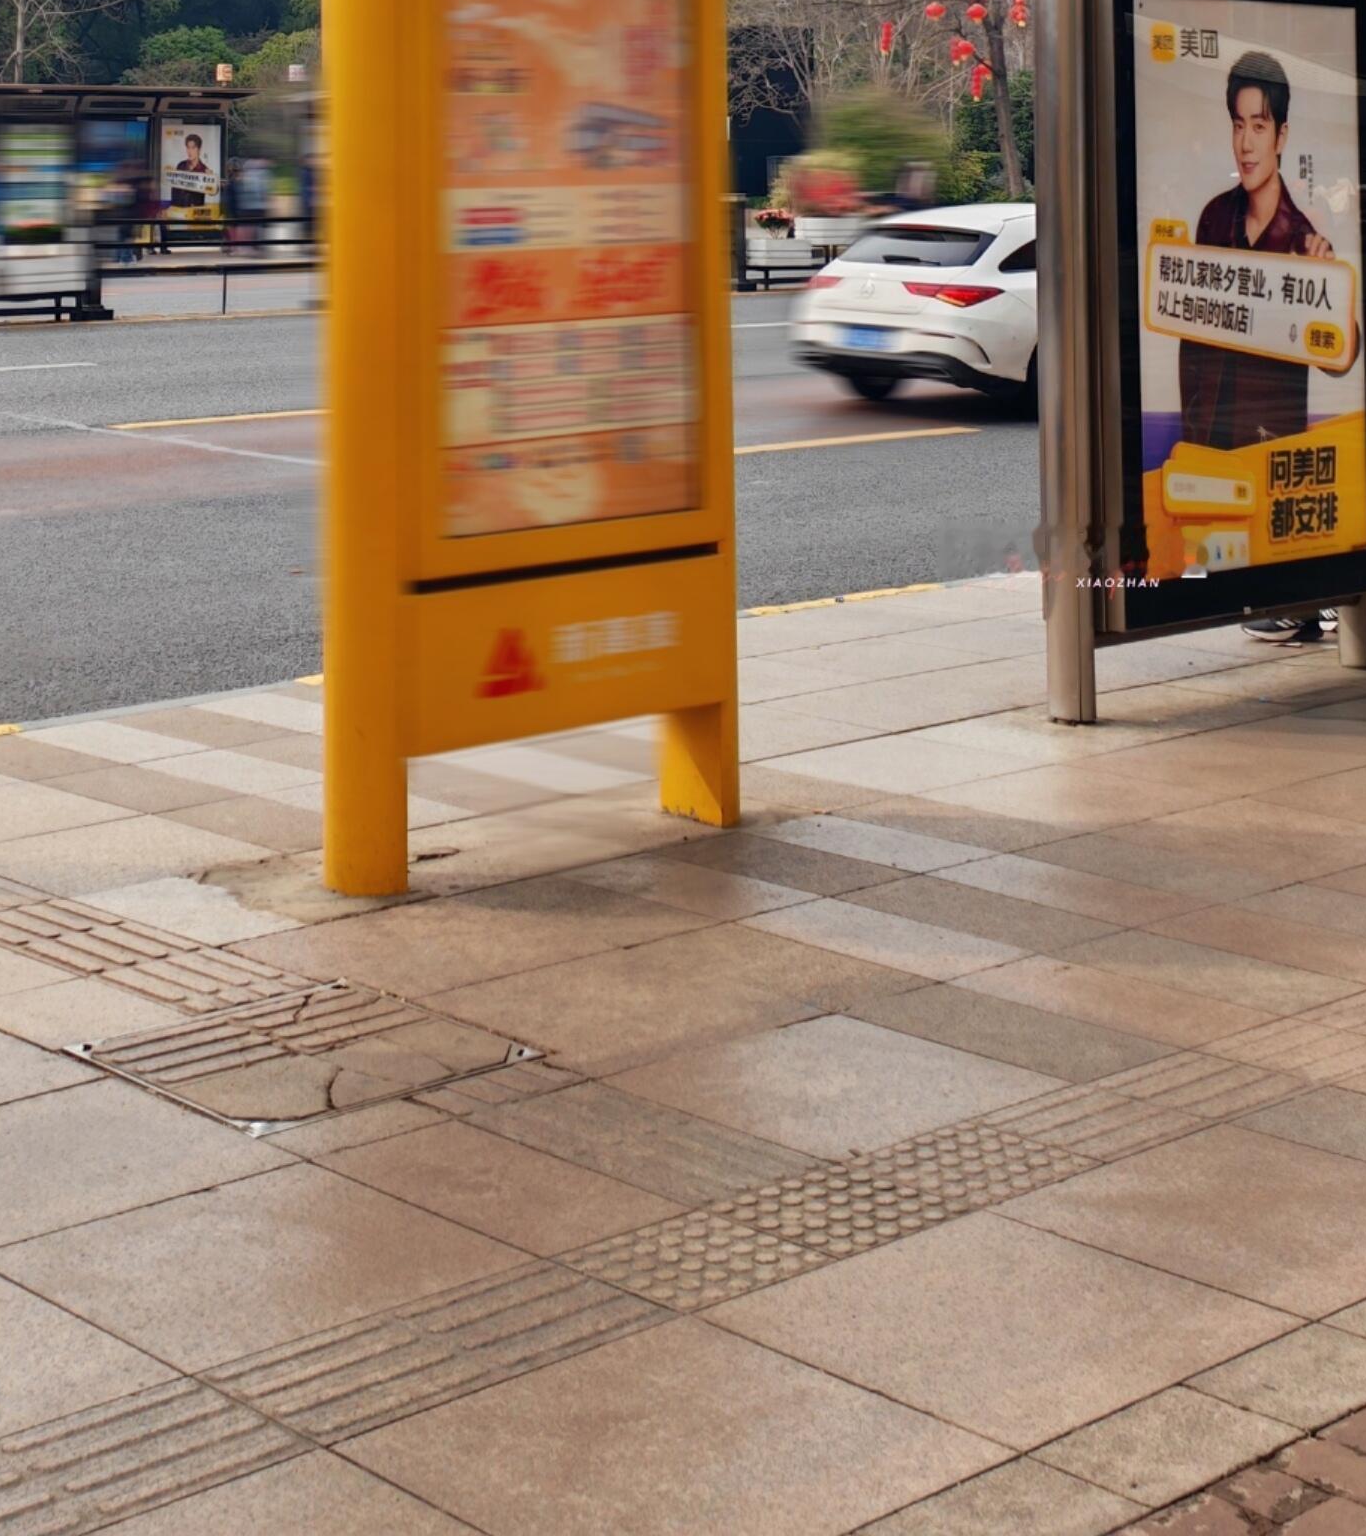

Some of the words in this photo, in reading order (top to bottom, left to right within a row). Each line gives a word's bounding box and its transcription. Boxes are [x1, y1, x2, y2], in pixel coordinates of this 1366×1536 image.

[1180, 28, 1219, 59] 美团
[1159, 255, 1332, 311] 帮找几家除夕营业，有10人
[1157, 290, 1249, 333] 以上包间的饭店
[1310, 329, 1336, 350] 搜索
[1270, 446, 1336, 491] 问美团
[1271, 492, 1338, 539] 都安排
